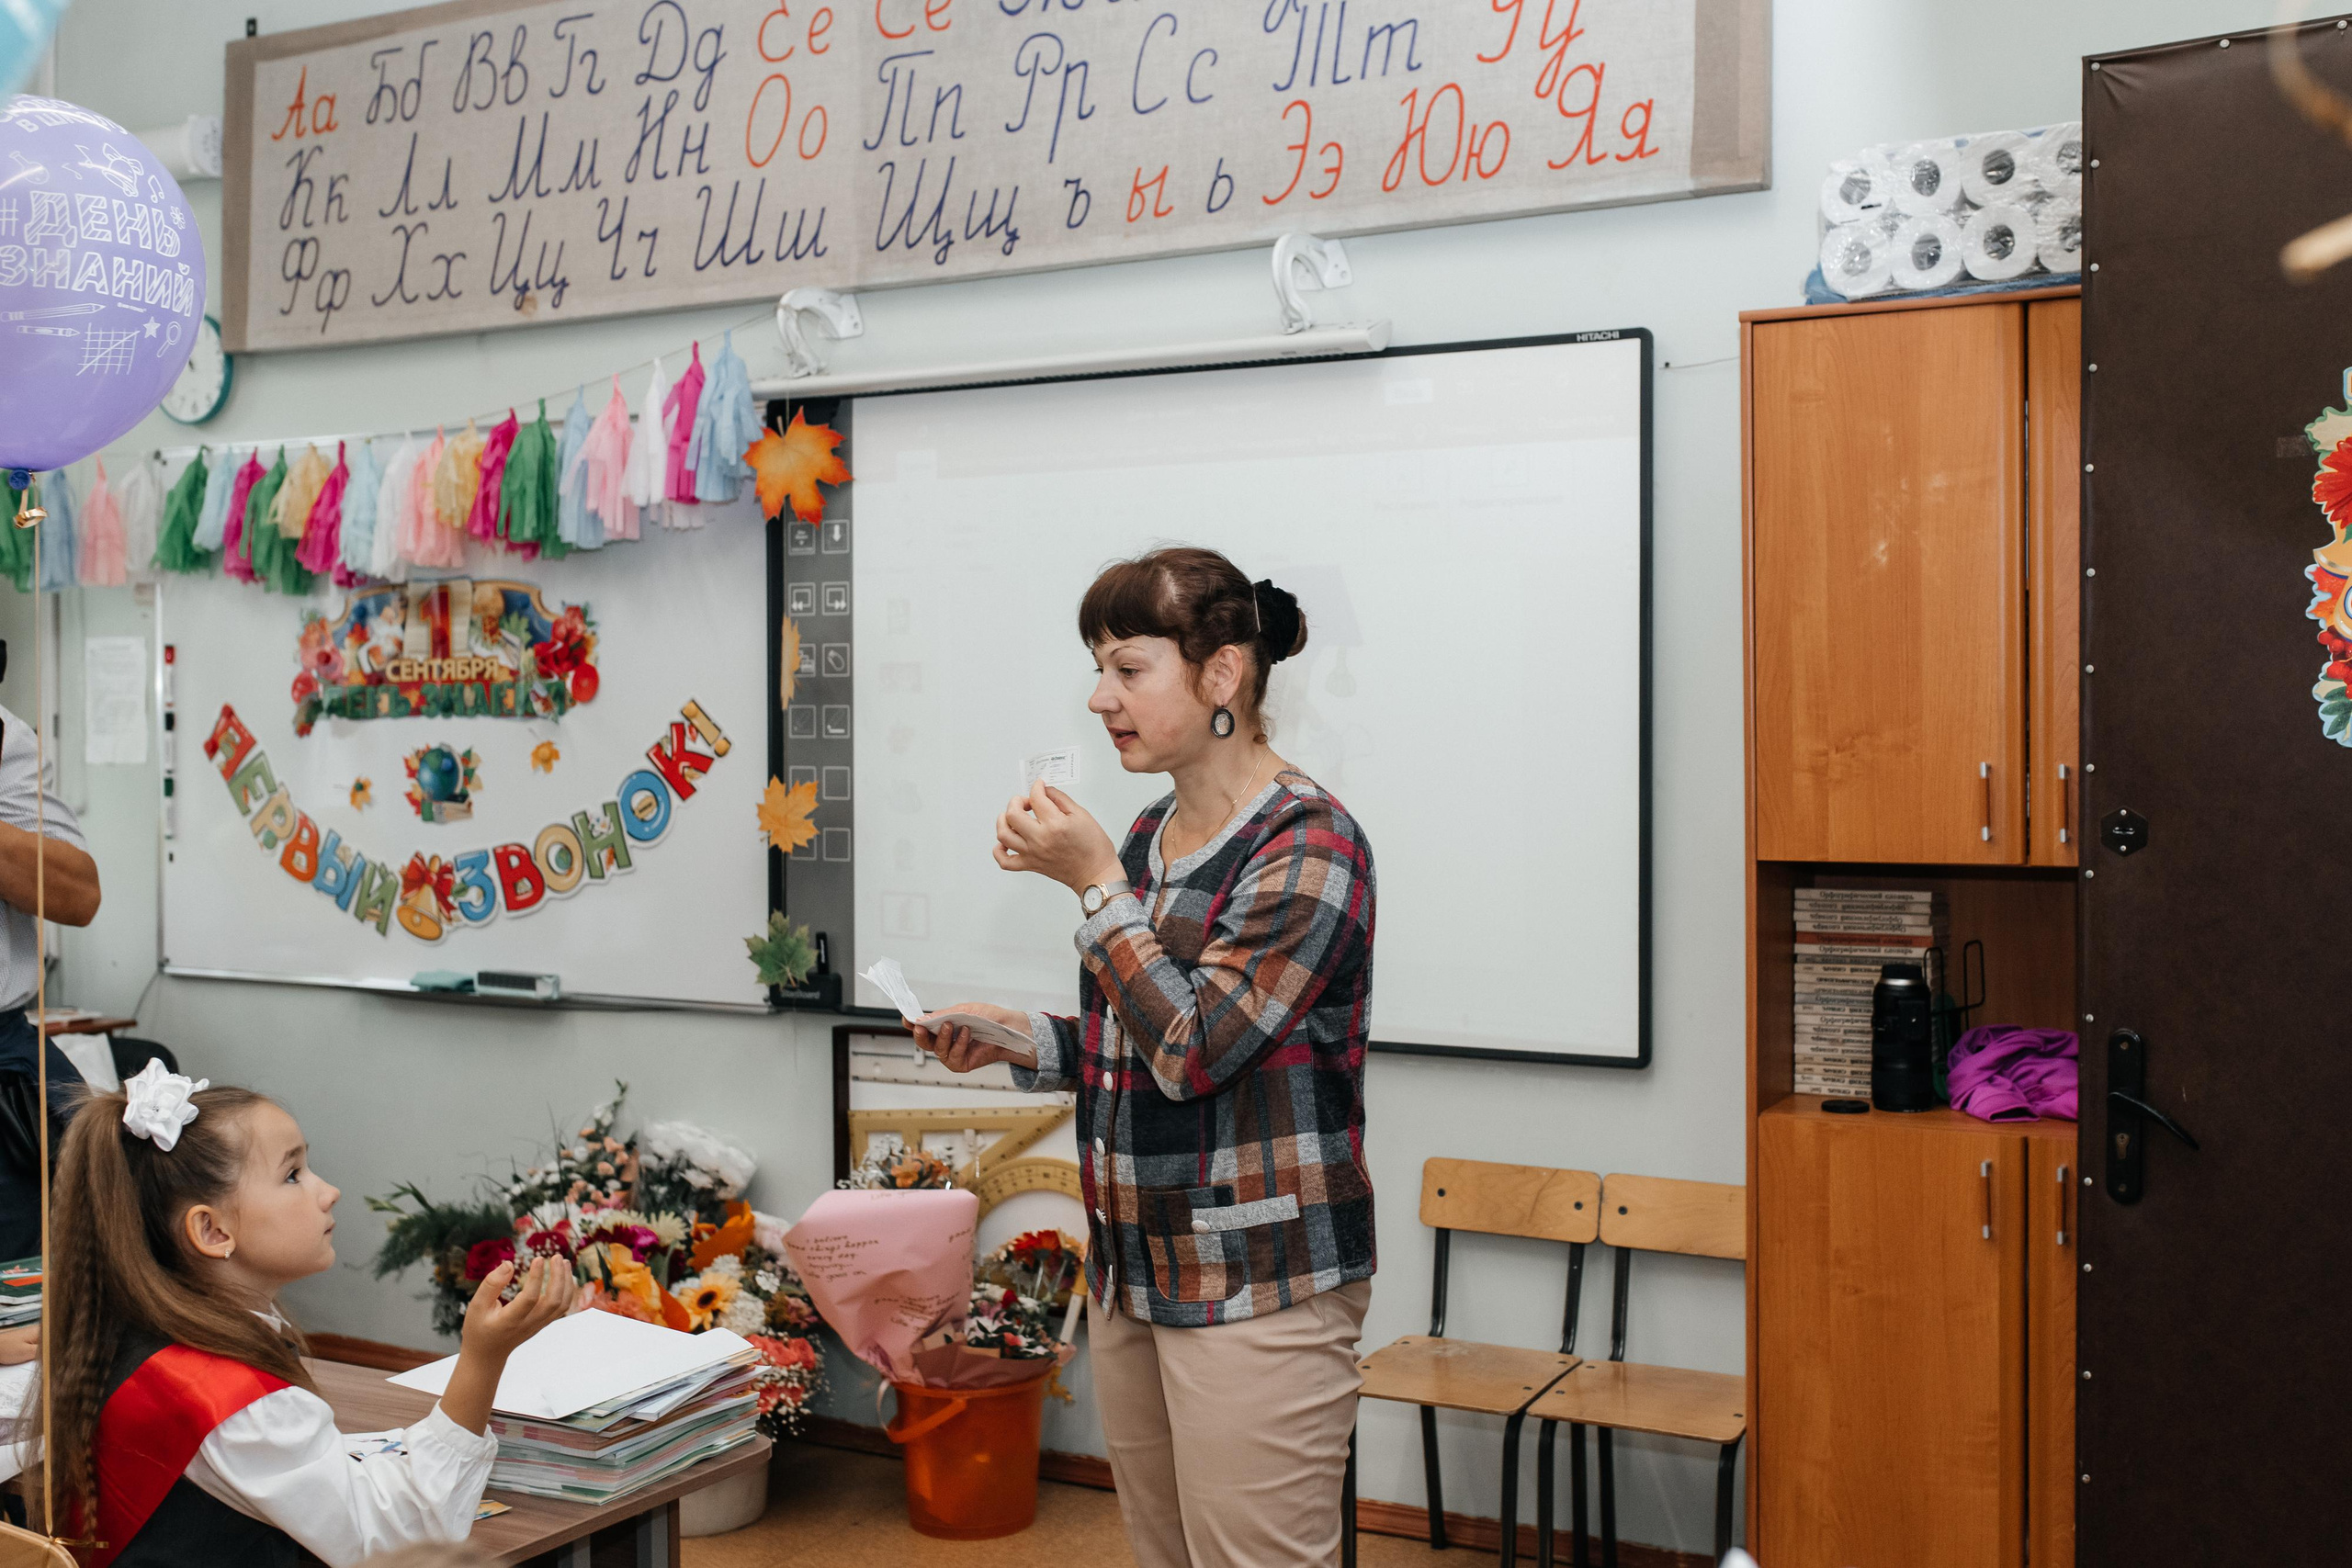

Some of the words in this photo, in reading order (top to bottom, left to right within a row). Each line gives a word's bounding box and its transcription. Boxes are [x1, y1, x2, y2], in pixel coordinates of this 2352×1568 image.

[271, 65, 340, 141] Аа
[366, 39, 439, 126] Бб
[452, 24, 528, 115] Вв
[548, 13, 606, 99] Гг
[635, 0, 728, 113] Дд
[279, 145, 349, 231] Кк
[379, 131, 458, 219] Лл
[488, 111, 602, 204] Мм
[625, 89, 710, 185] Нн
[746, 73, 828, 169] Оо
[863, 50, 966, 152] Пп
[1004, 31, 1096, 164] Рр
[1132, 12, 1219, 115] Сс
[279, 236, 351, 333] Фф
[371, 223, 467, 307] Хх
[489, 210, 571, 310] Цц
[694, 177, 829, 273] Шш
[875, 155, 1022, 266] Щщ
[1261, 99, 1344, 206] Ээ
[1382, 83, 1511, 193] Юю
[1547, 62, 1660, 170] Яя
[0, 244, 195, 317] ЗНАНИЙ
[1576, 331, 1621, 343] HITACHI
[385, 656, 500, 682] СЕНТЯБРЯ
[420, 584, 452, 660] 1
[203, 703, 399, 938] ПЕРВЫЙ
[454, 698, 732, 922] ЗВОНОК!
